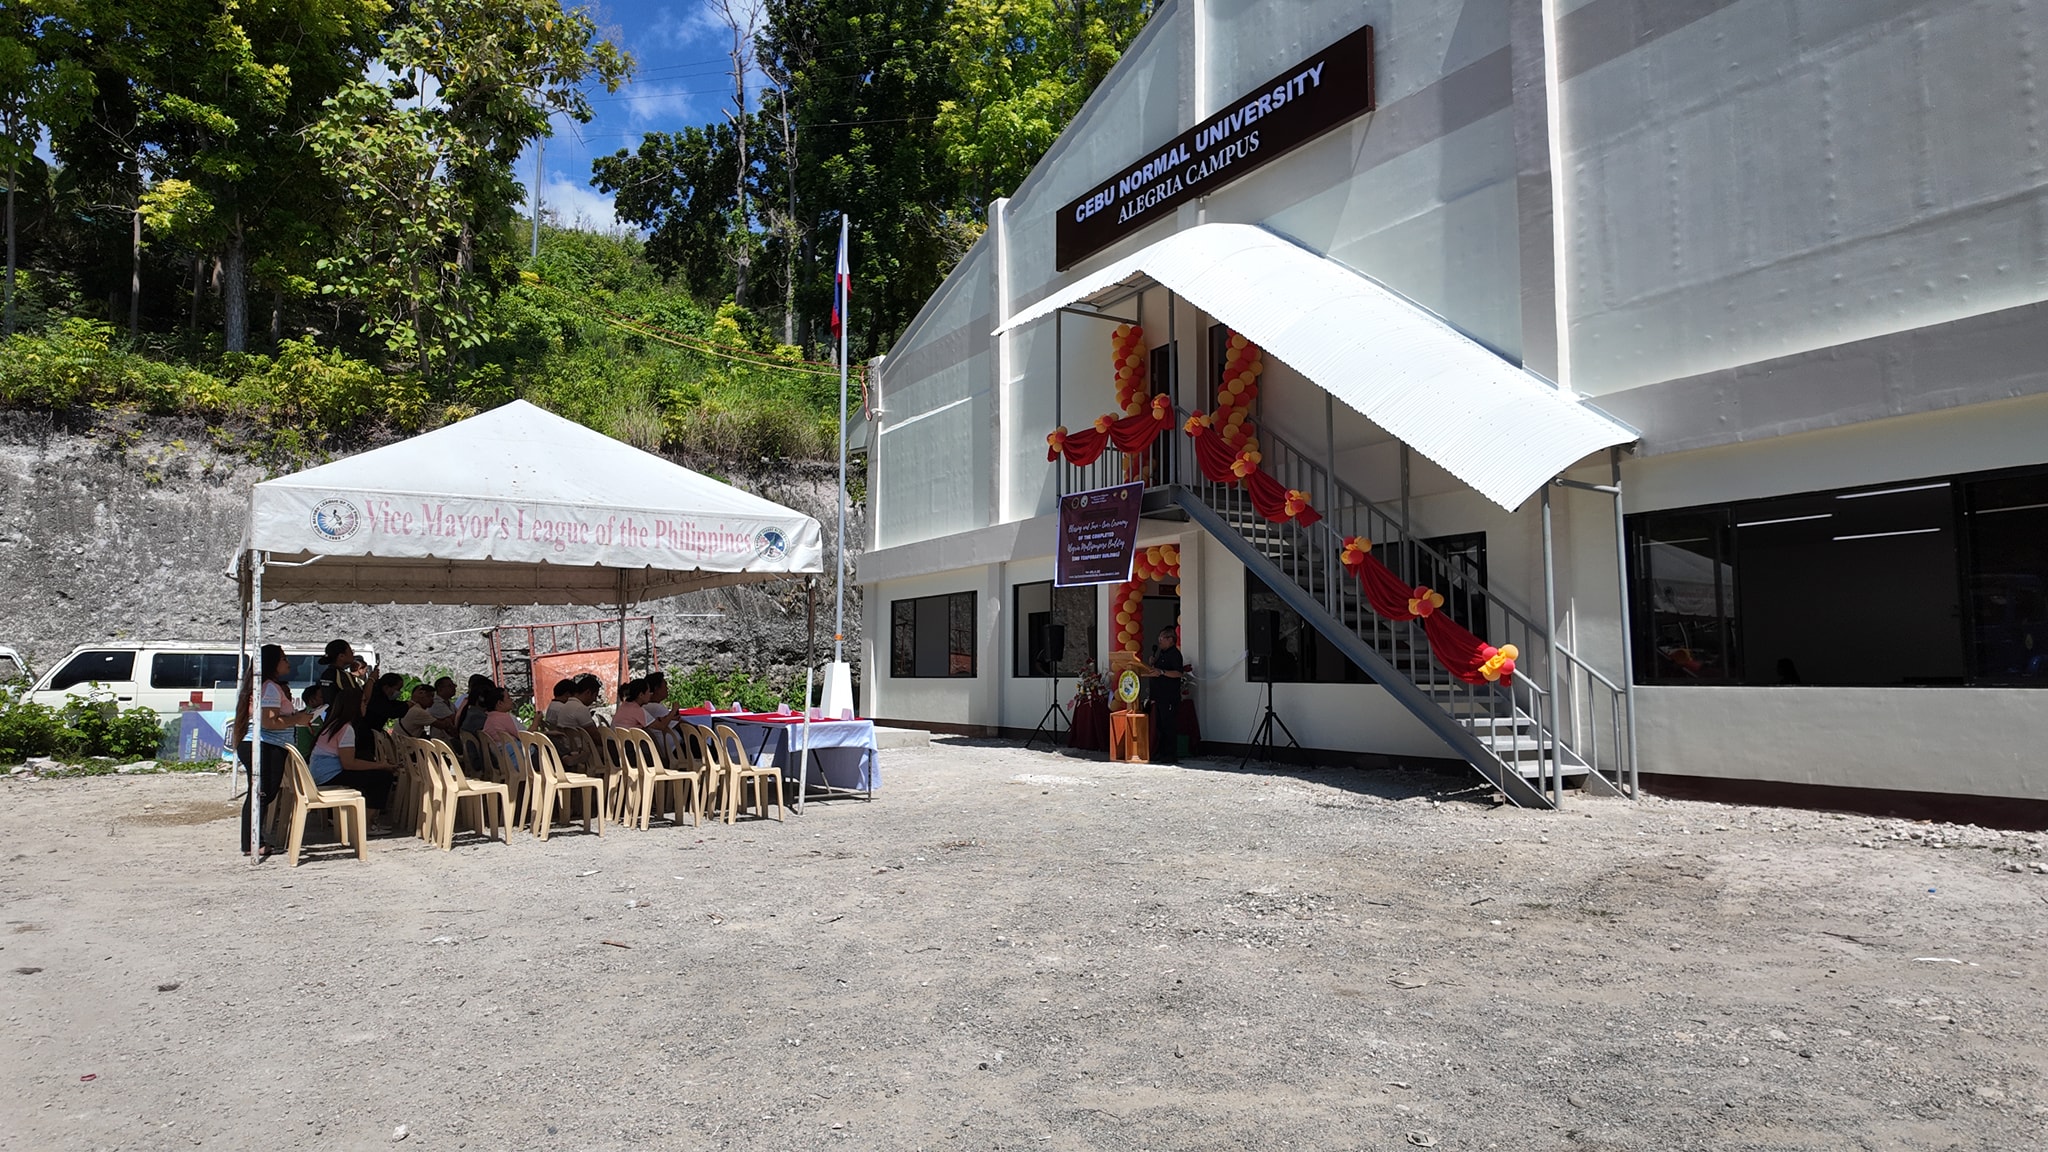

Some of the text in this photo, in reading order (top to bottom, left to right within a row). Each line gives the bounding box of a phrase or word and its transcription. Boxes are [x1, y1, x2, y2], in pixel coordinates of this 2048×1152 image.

[1076, 60, 1325, 222] CEBU NORMAL UNIVERSITY
[1117, 130, 1259, 224] ALEGRIA CAMPUS
[365, 500, 413, 536] Vice
[421, 503, 509, 547] Mayor's
[517, 509, 589, 552] League
[596, 515, 615, 546] of
[619, 517, 648, 548] the
[655, 519, 752, 560] Philippines
[1092, 531, 1114, 539] COMPLETED
